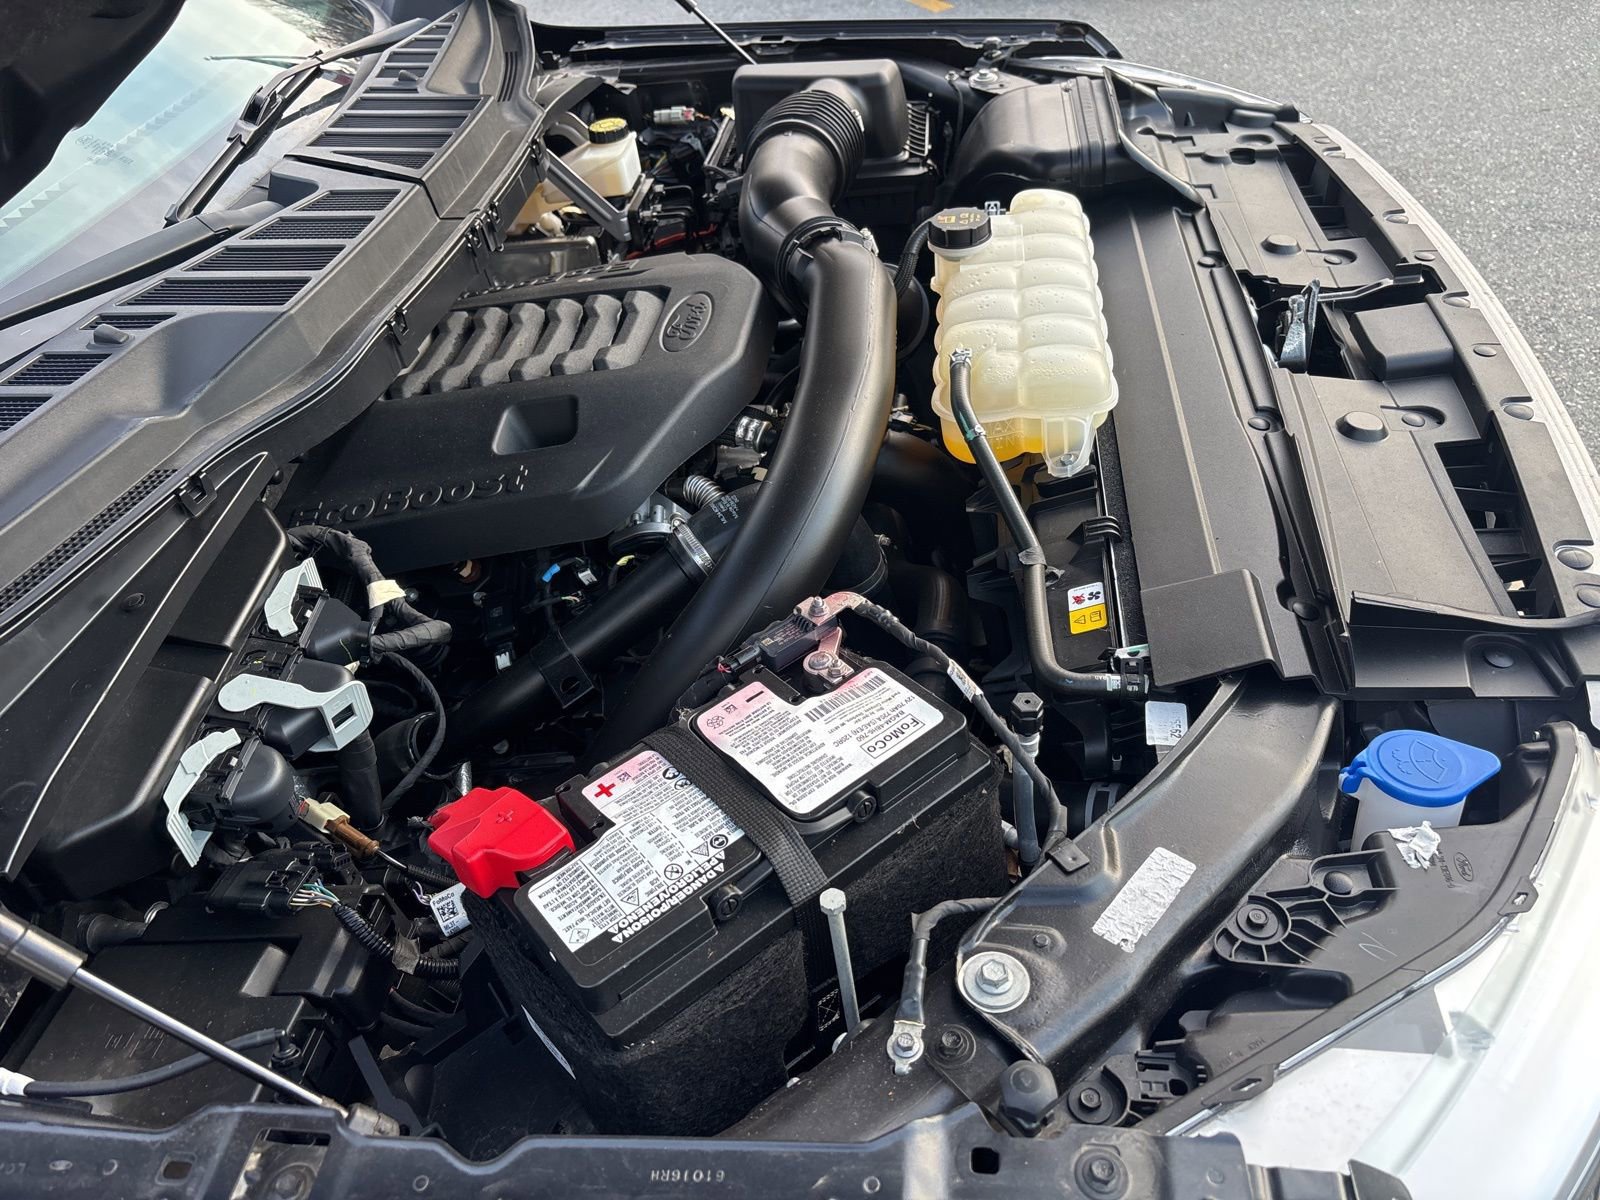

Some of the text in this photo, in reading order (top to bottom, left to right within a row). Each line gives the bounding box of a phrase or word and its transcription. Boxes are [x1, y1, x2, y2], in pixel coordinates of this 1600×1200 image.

[902, 694, 916, 703] 12V
[864, 717, 920, 755] FoMoCo
[432, 892, 455, 906] FoMoCo
[616, 856, 719, 929] PELIGRO/VENENO
[603, 903, 615, 913] WITH
[621, 869, 717, 937] DANGER/POISON
[583, 903, 603, 918] MEDICAL
[591, 907, 619, 928] IMMEDIATELY
[572, 915, 586, 926] HELP
[597, 920, 609, 930] EYES
